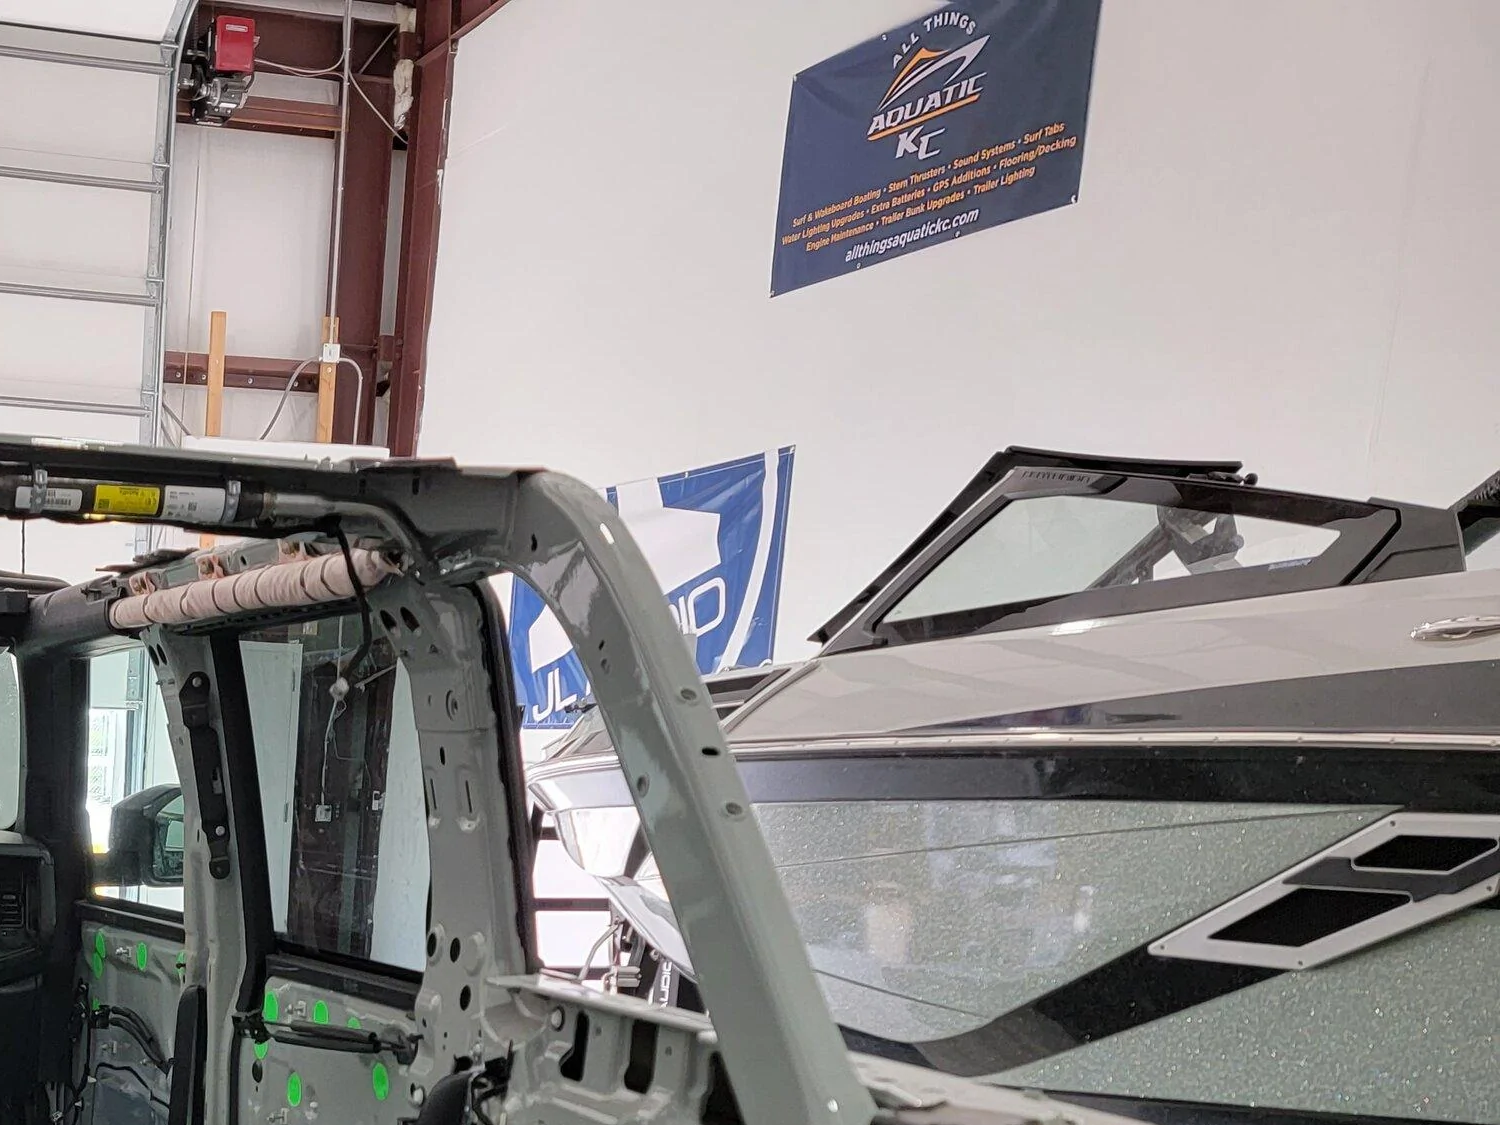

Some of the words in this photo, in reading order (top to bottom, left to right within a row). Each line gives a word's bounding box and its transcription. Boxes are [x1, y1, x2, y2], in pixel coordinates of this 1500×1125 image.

[893, 32, 920, 69] ALL
[923, 12, 976, 35] THINGS
[867, 72, 987, 136] AQUATIC
[895, 125, 946, 160] KC
[793, 213, 807, 227] Surf
[814, 197, 853, 220] Wakeboard
[910, 165, 946, 185] Thrusters
[953, 152, 979, 170] Sound
[981, 140, 1016, 160] Systems
[1023, 128, 1044, 144] Surf
[1044, 121, 1065, 136] Tabs
[802, 221, 831, 239] Lighting
[831, 209, 865, 228] Upgrades
[871, 200, 891, 214] Extra
[891, 187, 925, 207] Batteries
[932, 178, 950, 193] GPS
[951, 165, 991, 186] Additions
[806, 237, 830, 251] Engine
[881, 210, 905, 226] Trailer
[905, 202, 926, 218] Bunk
[926, 191, 965, 211] Upgrades
[973, 178, 999, 195] Trailer
[1001, 166, 1036, 187] Lighting
[845, 208, 979, 263] allthingsaquatickc.com
[532, 667, 577, 722] JL
